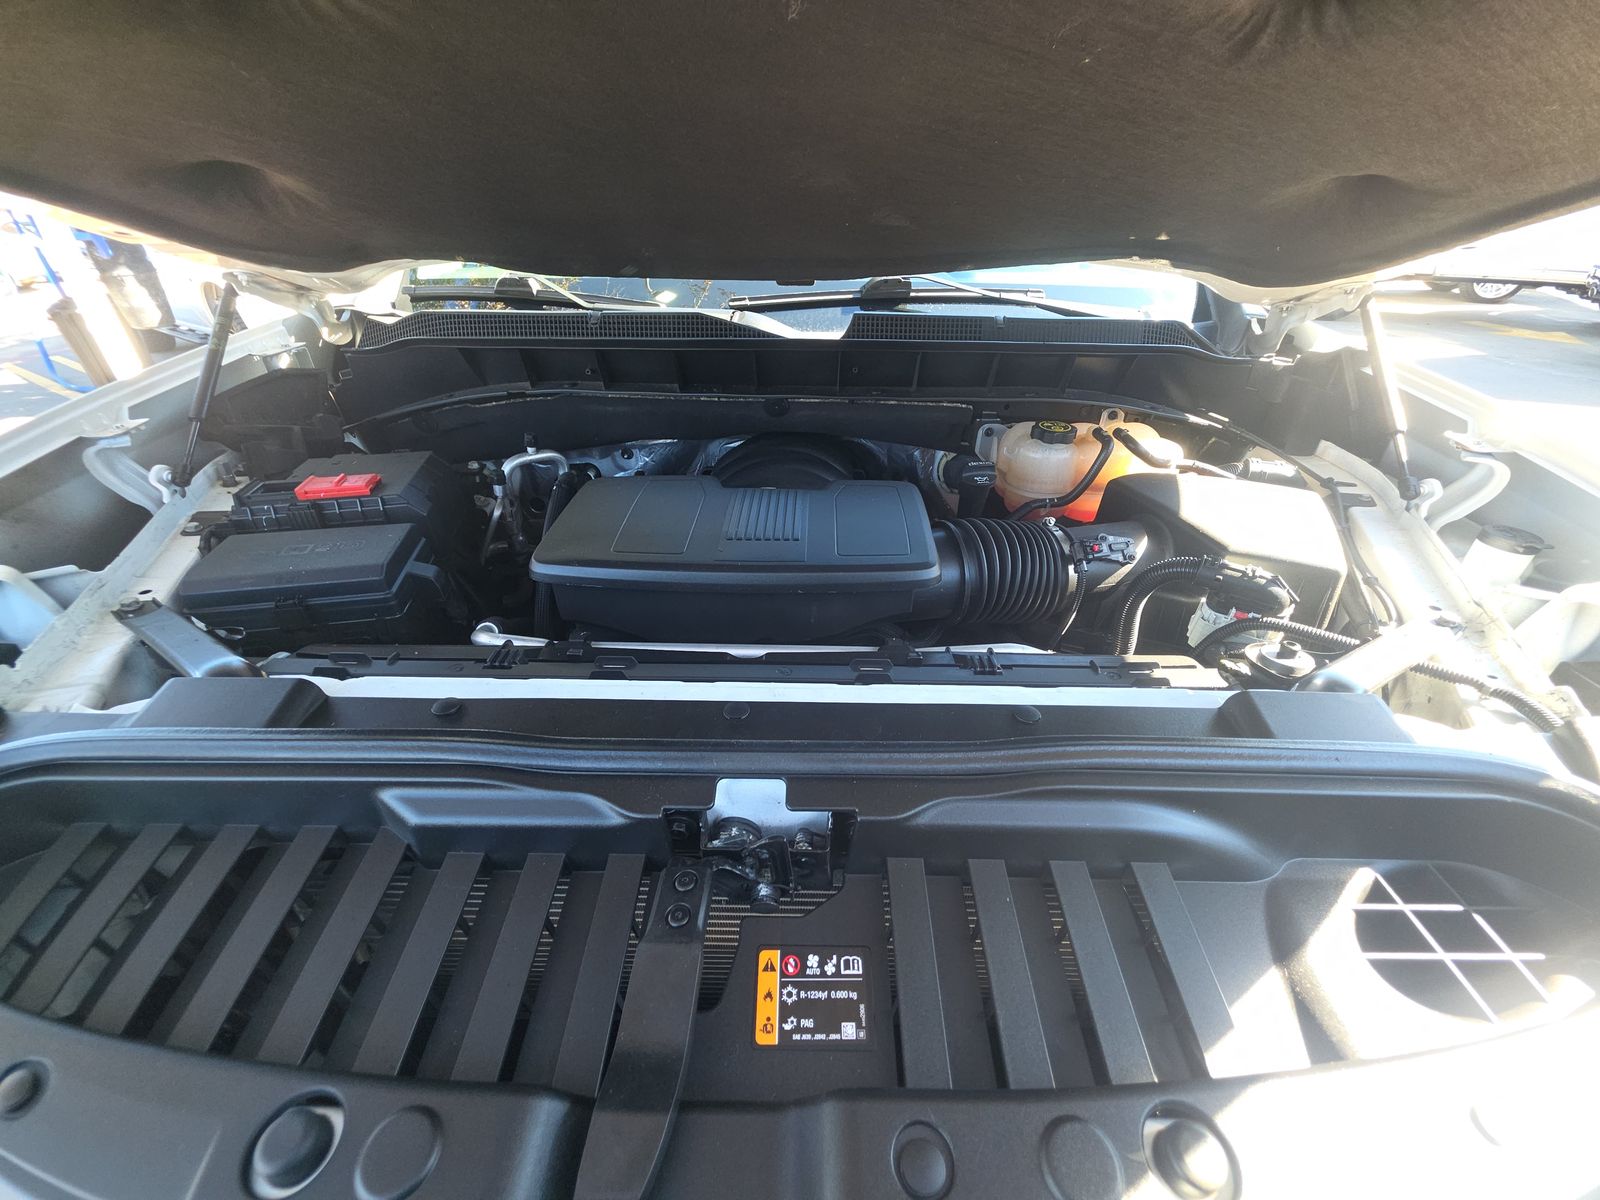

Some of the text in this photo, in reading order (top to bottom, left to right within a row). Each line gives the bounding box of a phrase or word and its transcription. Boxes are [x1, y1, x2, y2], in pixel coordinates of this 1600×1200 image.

[805, 967, 821, 975] AUTO
[800, 990, 858, 1000] R-1234yf 0.600 kg
[800, 1018, 814, 1028] PAG
